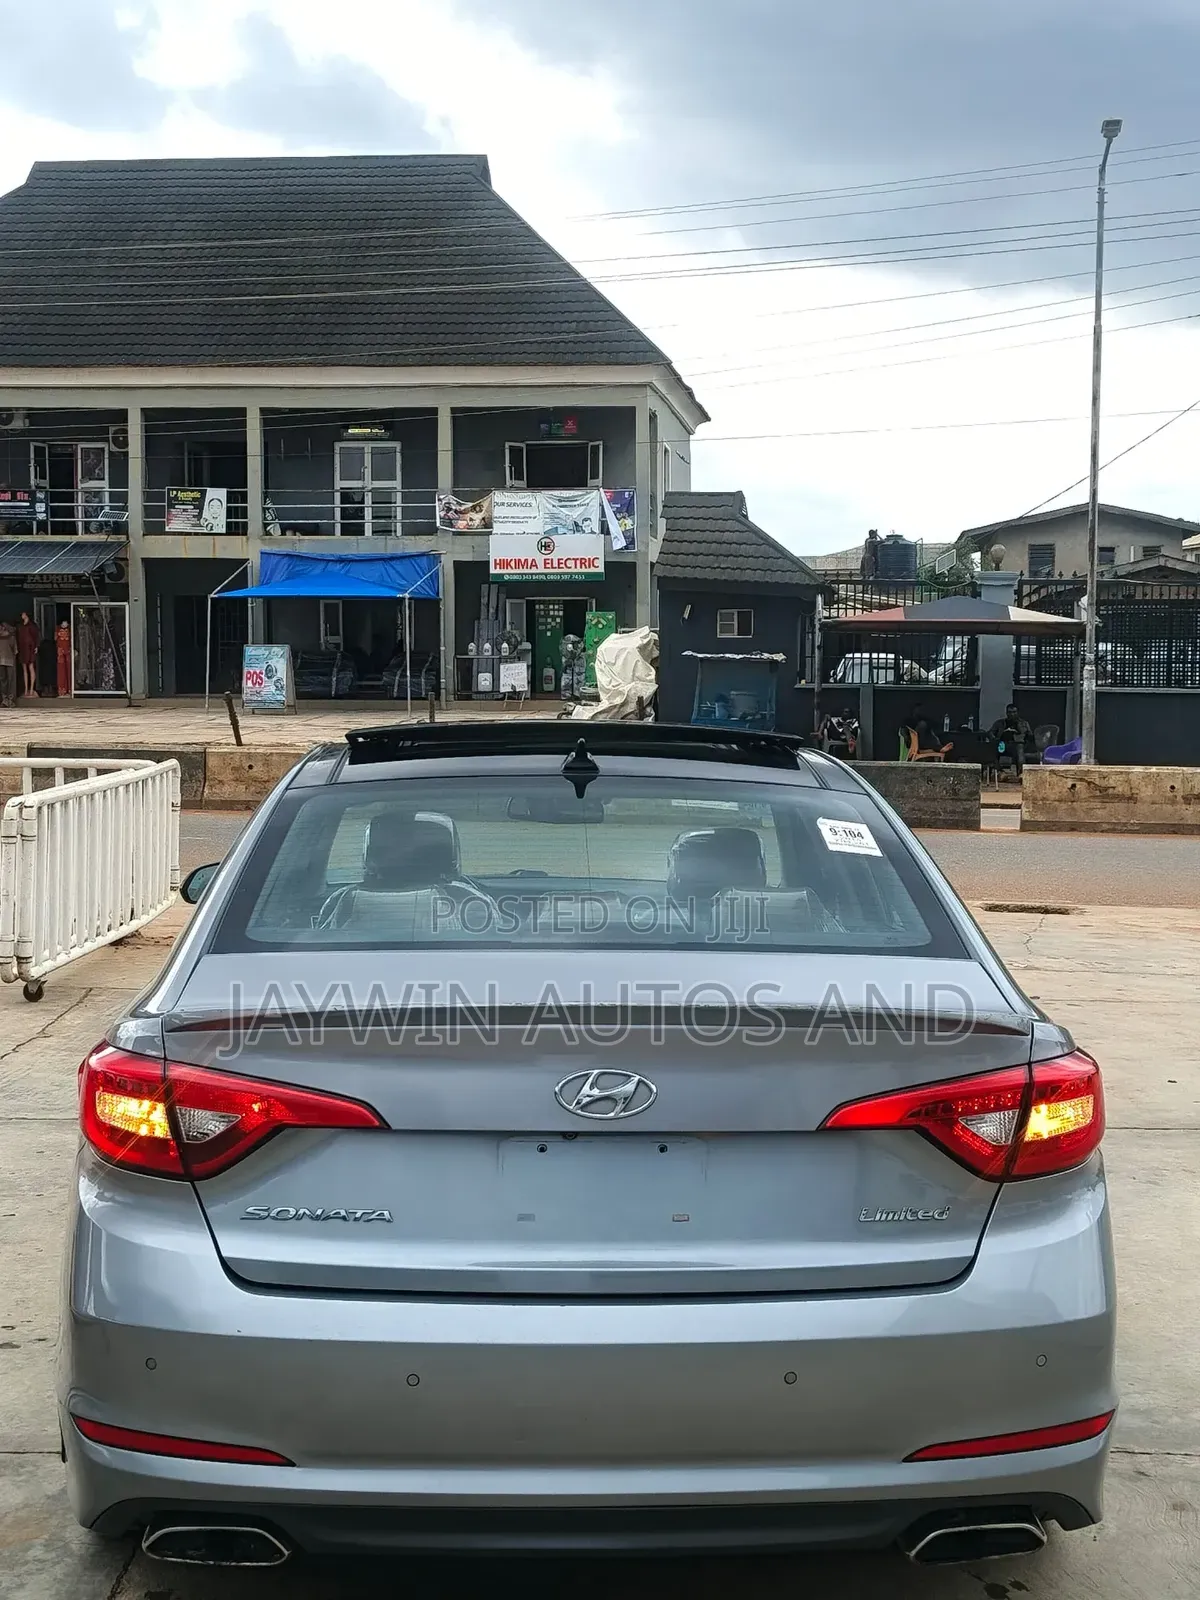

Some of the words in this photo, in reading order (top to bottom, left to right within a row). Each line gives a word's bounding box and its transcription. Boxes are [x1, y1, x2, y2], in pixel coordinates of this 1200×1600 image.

[493, 558, 539, 570] HIKIMA
[543, 557, 600, 570] ELECTRIC
[245, 670, 264, 687] POS
[239, 1206, 394, 1223] SONATA
[858, 1205, 951, 1223] Limited
